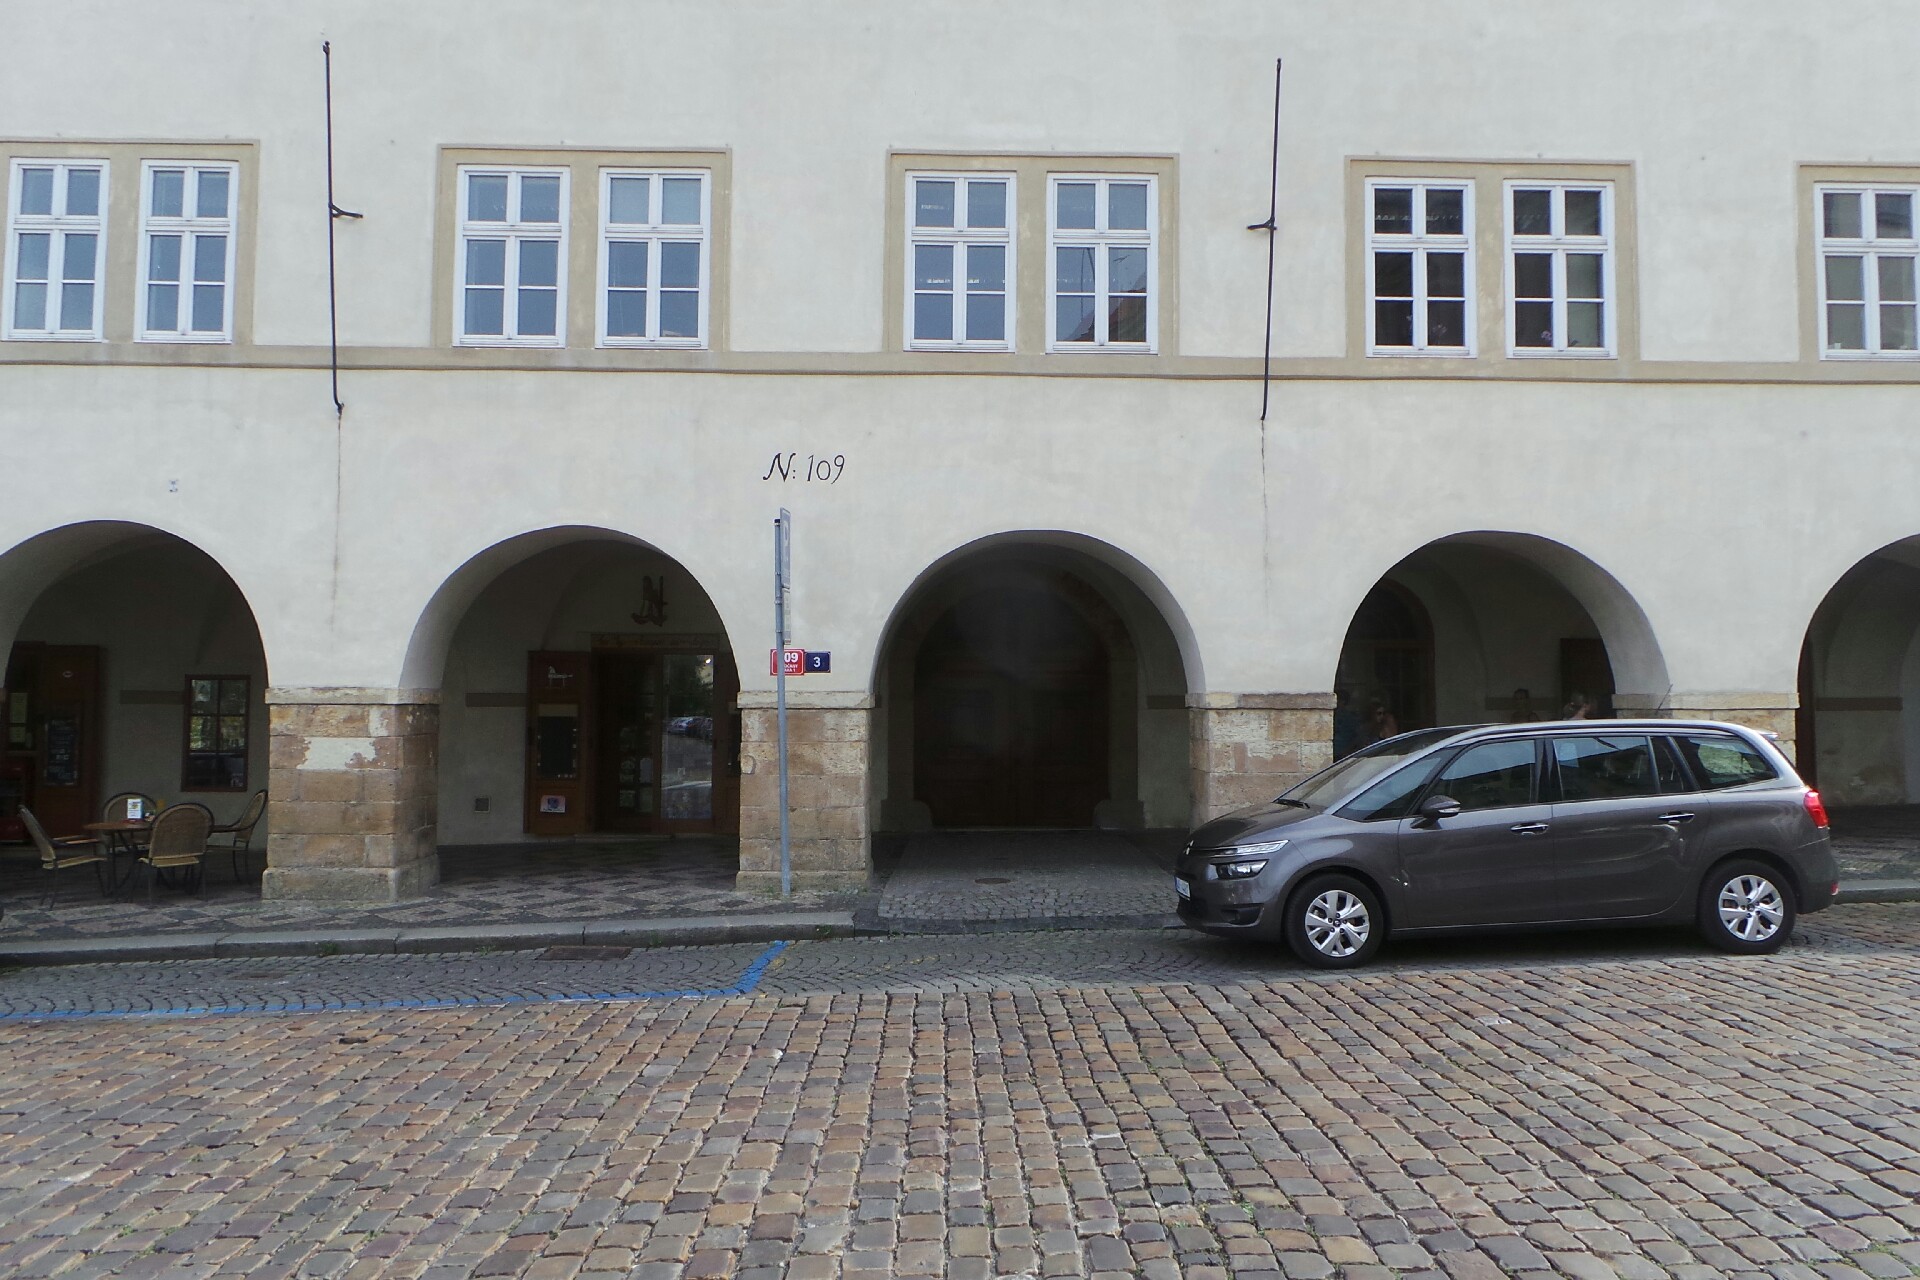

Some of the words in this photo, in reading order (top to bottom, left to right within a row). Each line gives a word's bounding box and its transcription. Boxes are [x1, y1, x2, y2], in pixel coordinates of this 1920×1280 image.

[806, 454, 845, 484] 109
[784, 652, 798, 663] 09
[813, 656, 821, 668] 3
